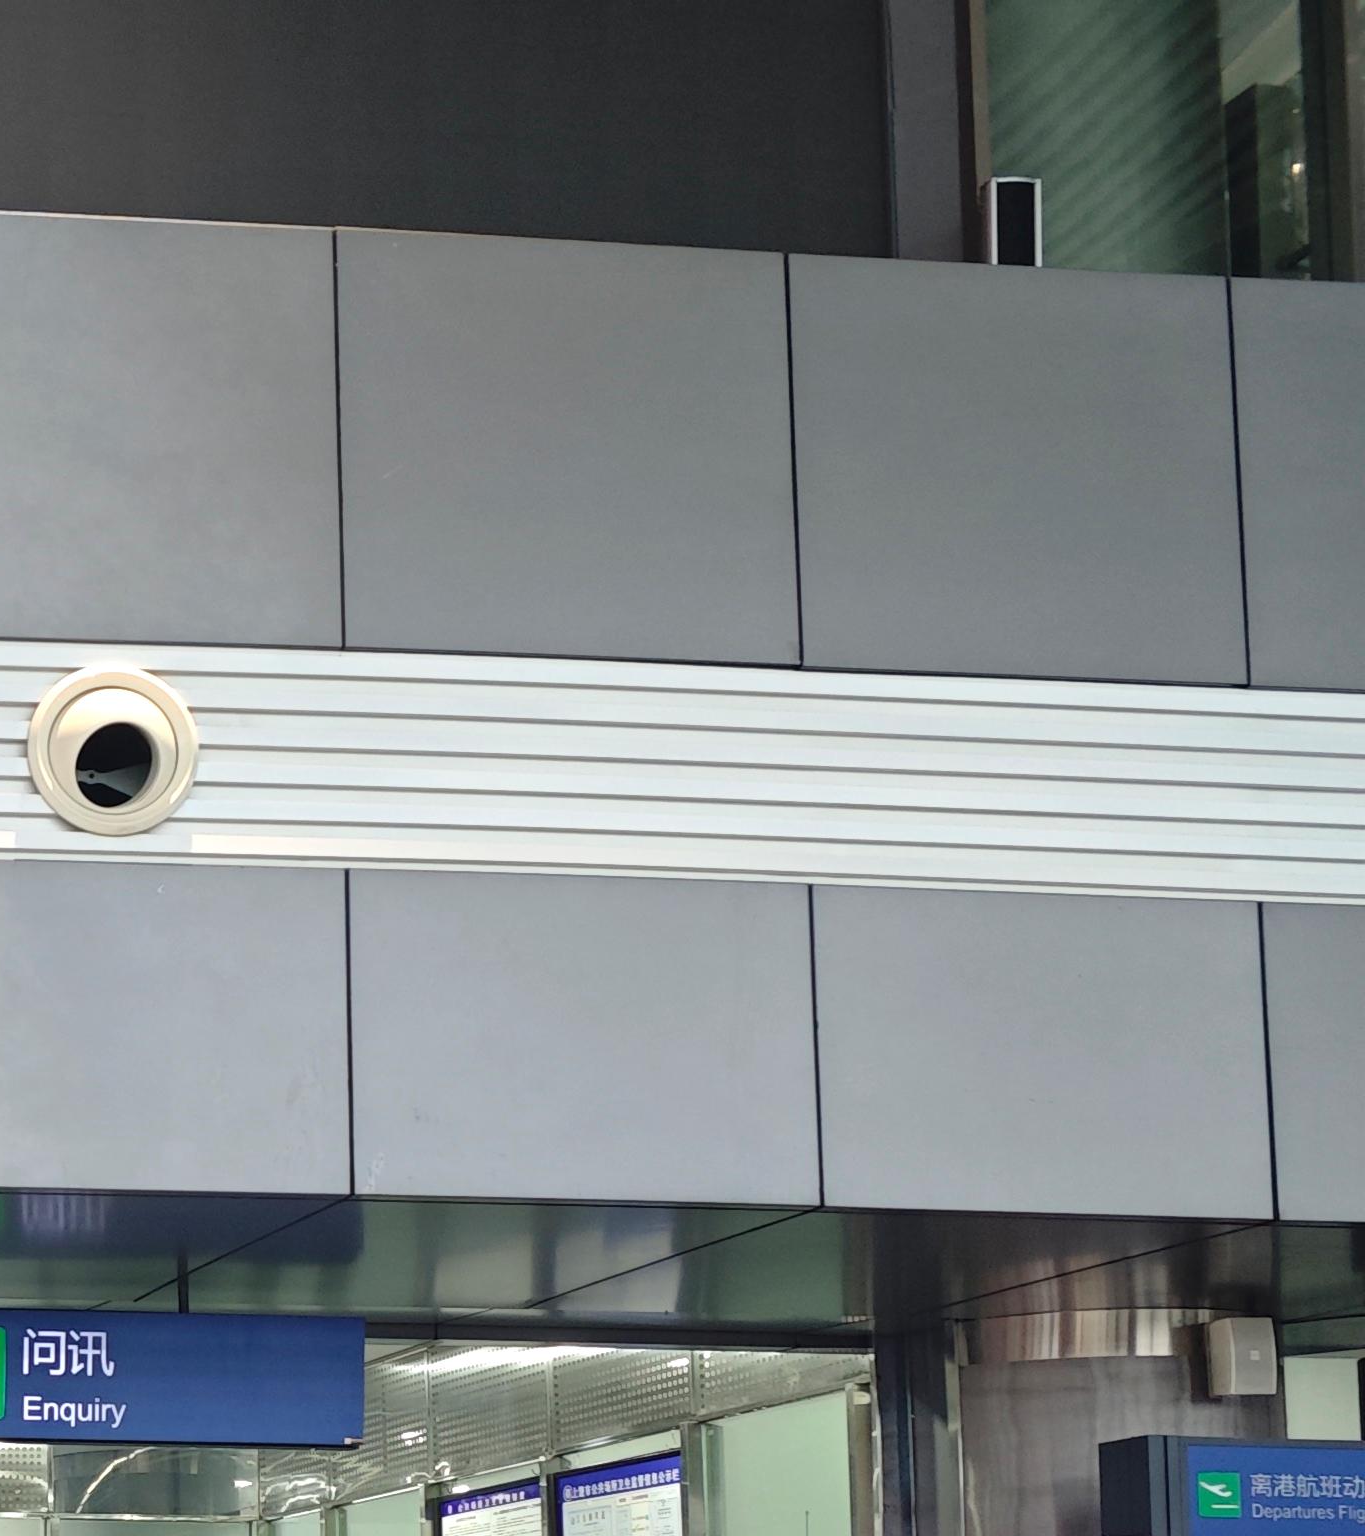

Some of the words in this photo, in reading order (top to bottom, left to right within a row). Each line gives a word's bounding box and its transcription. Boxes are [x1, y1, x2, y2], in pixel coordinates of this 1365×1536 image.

[22, 1328, 115, 1377] 问讯
[22, 1395, 127, 1428] Enquiry
[1252, 1503, 1334, 1521] Departures
